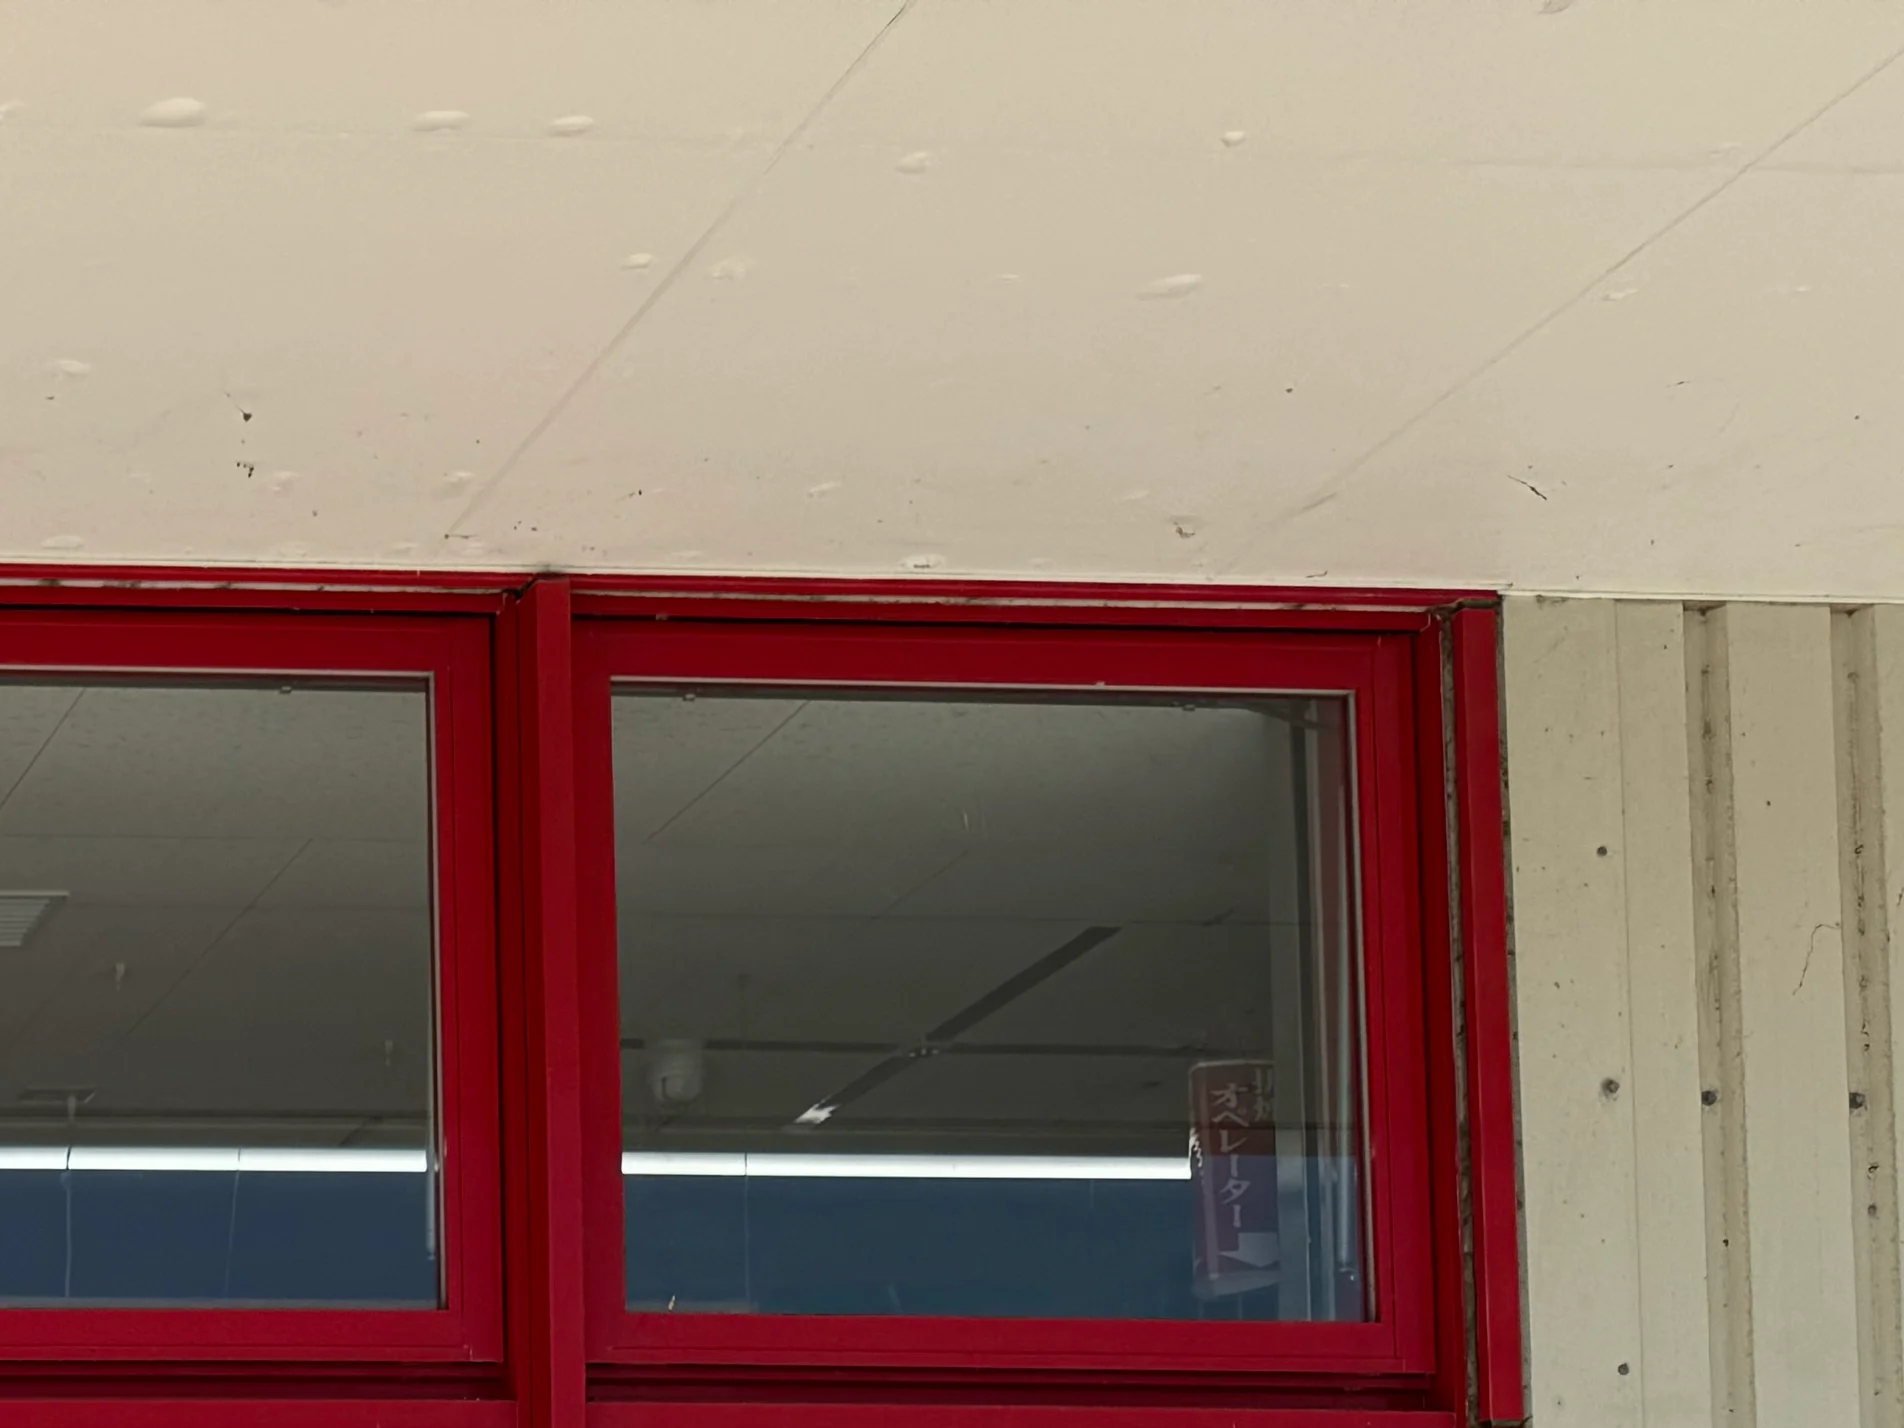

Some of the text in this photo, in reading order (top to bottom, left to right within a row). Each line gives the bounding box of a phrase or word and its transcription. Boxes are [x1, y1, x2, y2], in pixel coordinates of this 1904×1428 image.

[1209, 1082, 1251, 1228] オペレーター
